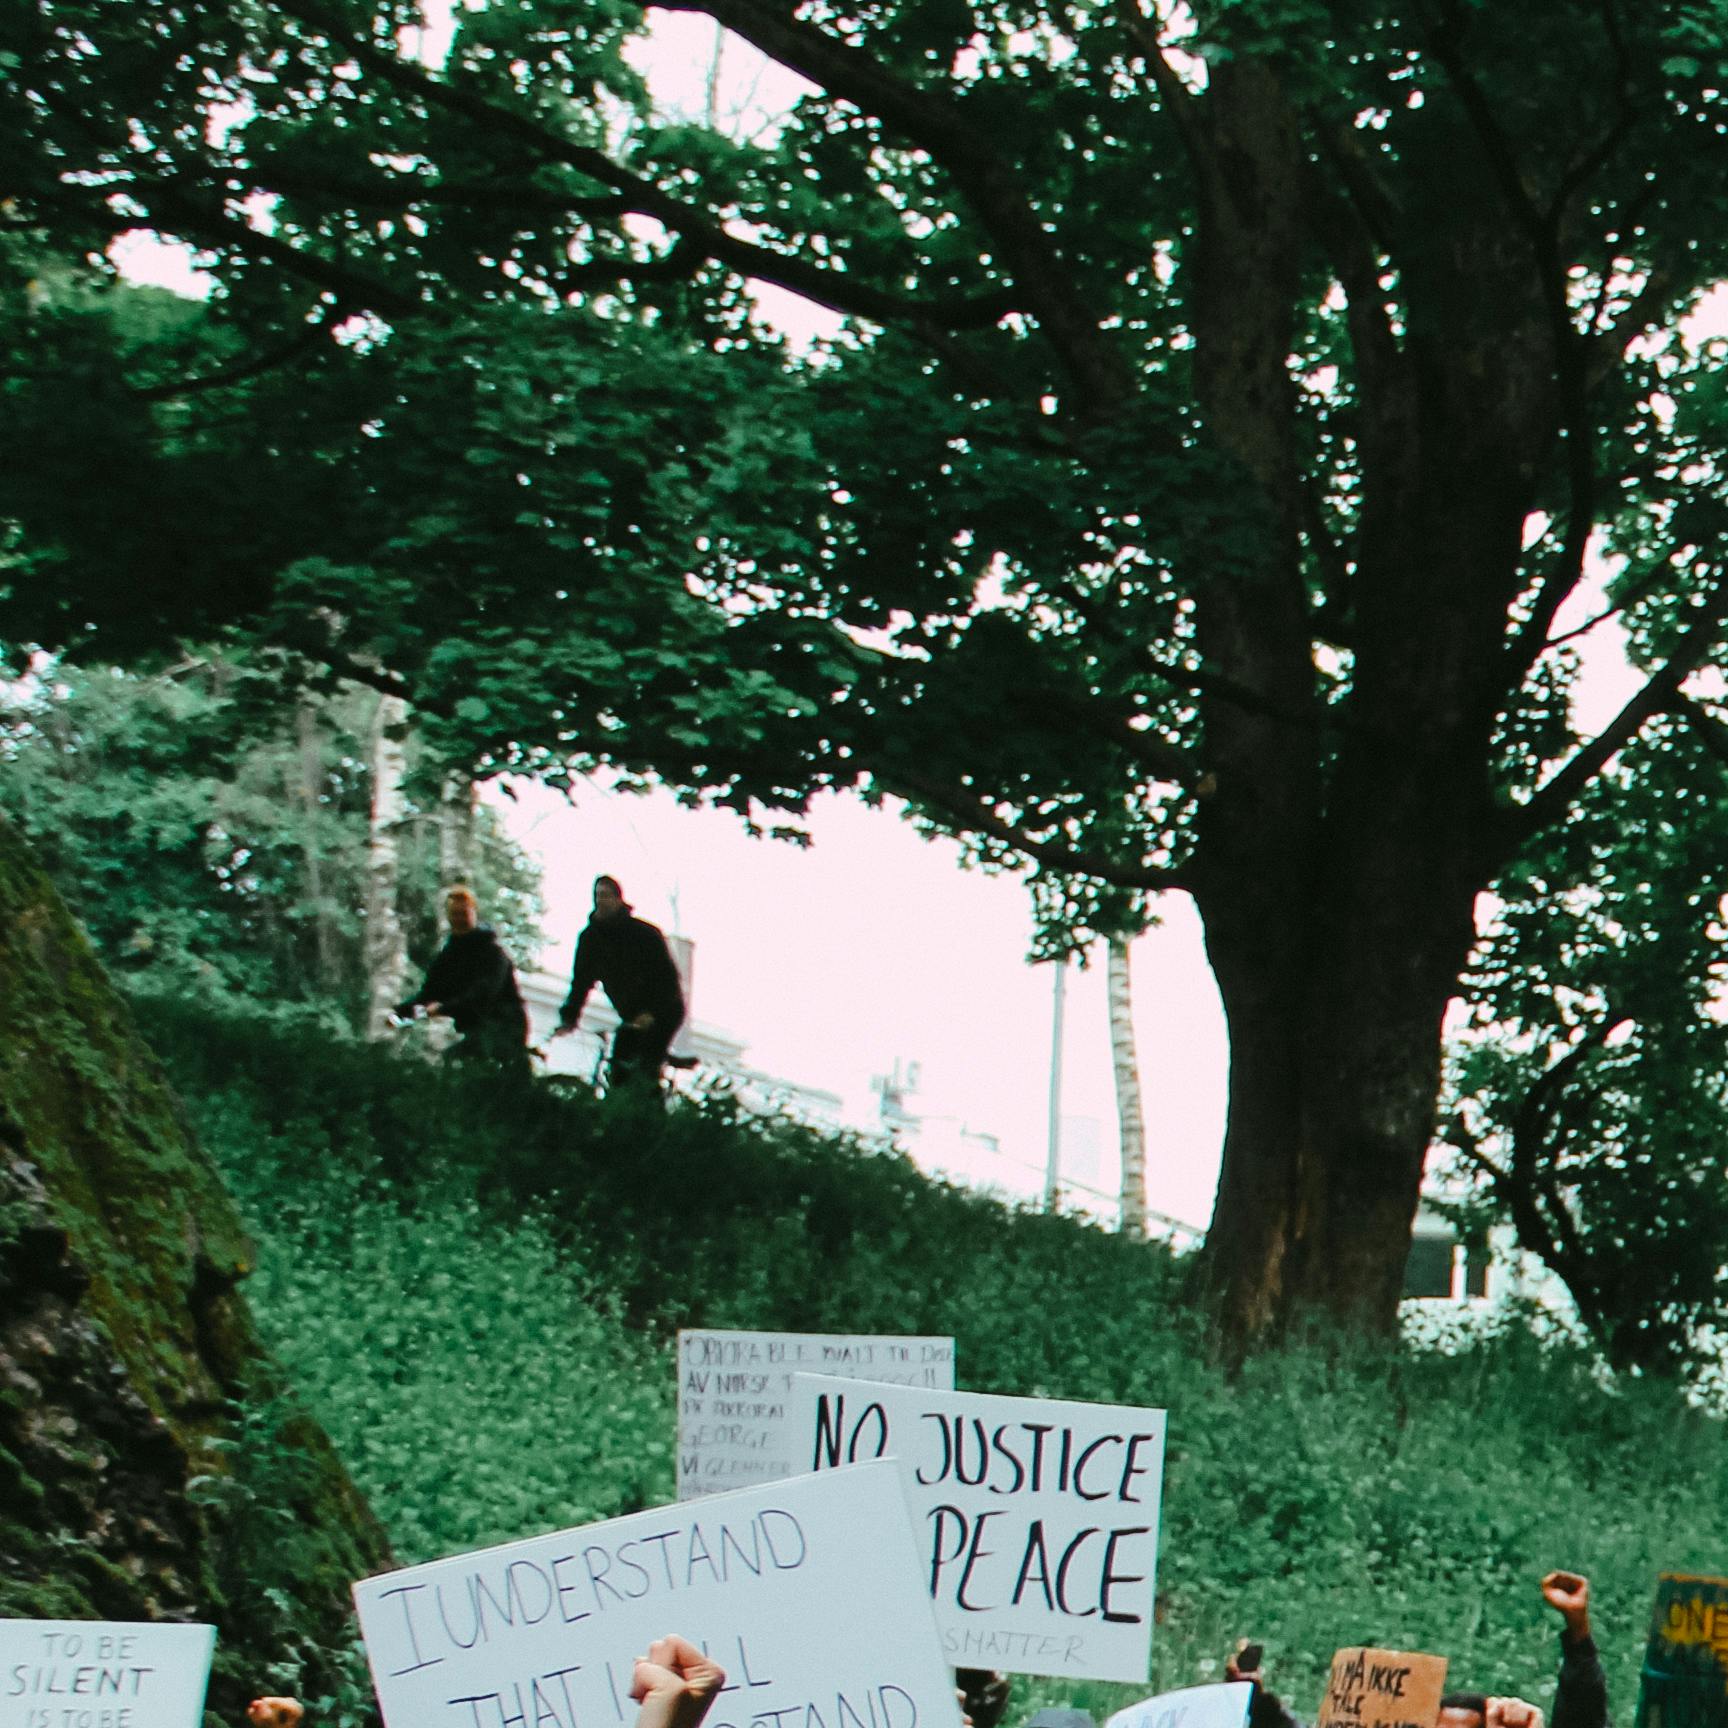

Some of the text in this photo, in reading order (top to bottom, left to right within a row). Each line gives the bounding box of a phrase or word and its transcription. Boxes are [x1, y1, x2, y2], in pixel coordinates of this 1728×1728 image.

[915, 1413, 1154, 1504] JUSTICE
[379, 1509, 807, 1677] I UNDERSTAND
[926, 1505, 1152, 1625] PEACE
[8, 1664, 156, 1697] SILENT
[43, 1633, 139, 1660] TO BE
